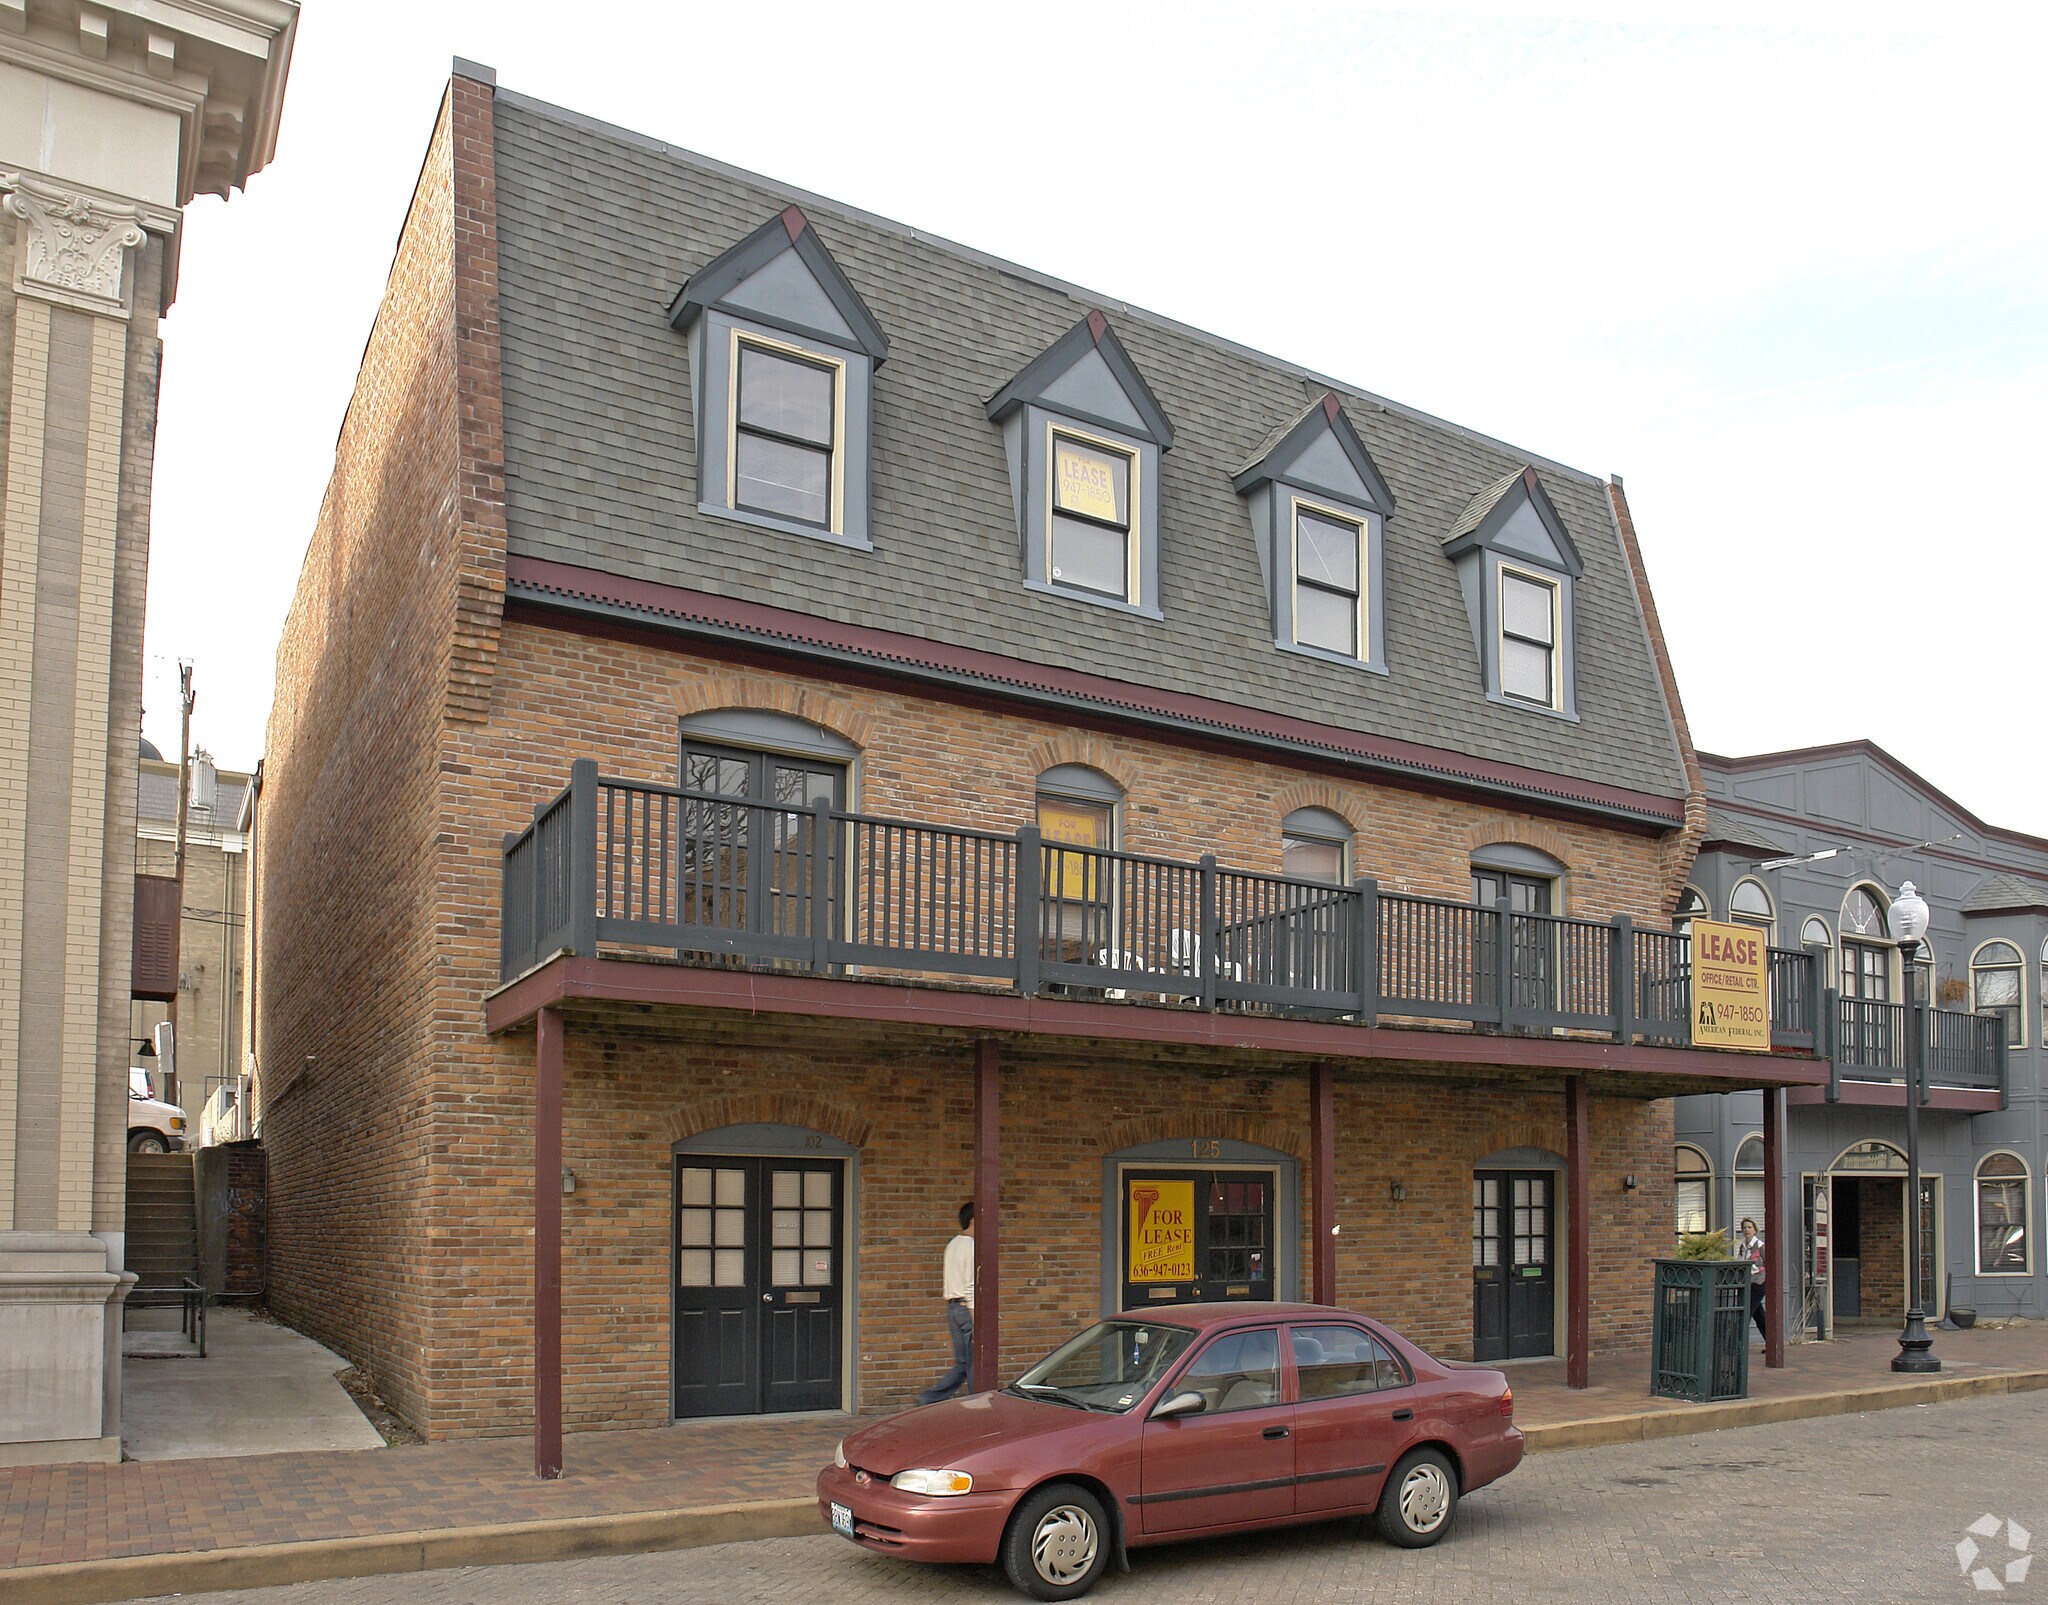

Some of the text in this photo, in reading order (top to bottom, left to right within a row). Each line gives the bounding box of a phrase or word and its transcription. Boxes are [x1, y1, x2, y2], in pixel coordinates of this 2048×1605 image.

[1064, 459, 1107, 489] LEASE
[1063, 478, 1111, 503] 947-1850
[1058, 818, 1077, 830] FOR
[1701, 933, 1758, 966] LEASE
[1701, 972, 1760, 989] OFFICE/RETAIL CTR.
[1717, 1003, 1764, 1023] 947-1850
[805, 1135, 823, 1149] 102
[1191, 1139, 1220, 1159] 125
[1153, 1209, 1183, 1225] FOR
[1144, 1228, 1192, 1245] LEASE
[1143, 1243, 1183, 1261] FREE Rent
[1133, 1262, 1191, 1278] 636-947-0123
